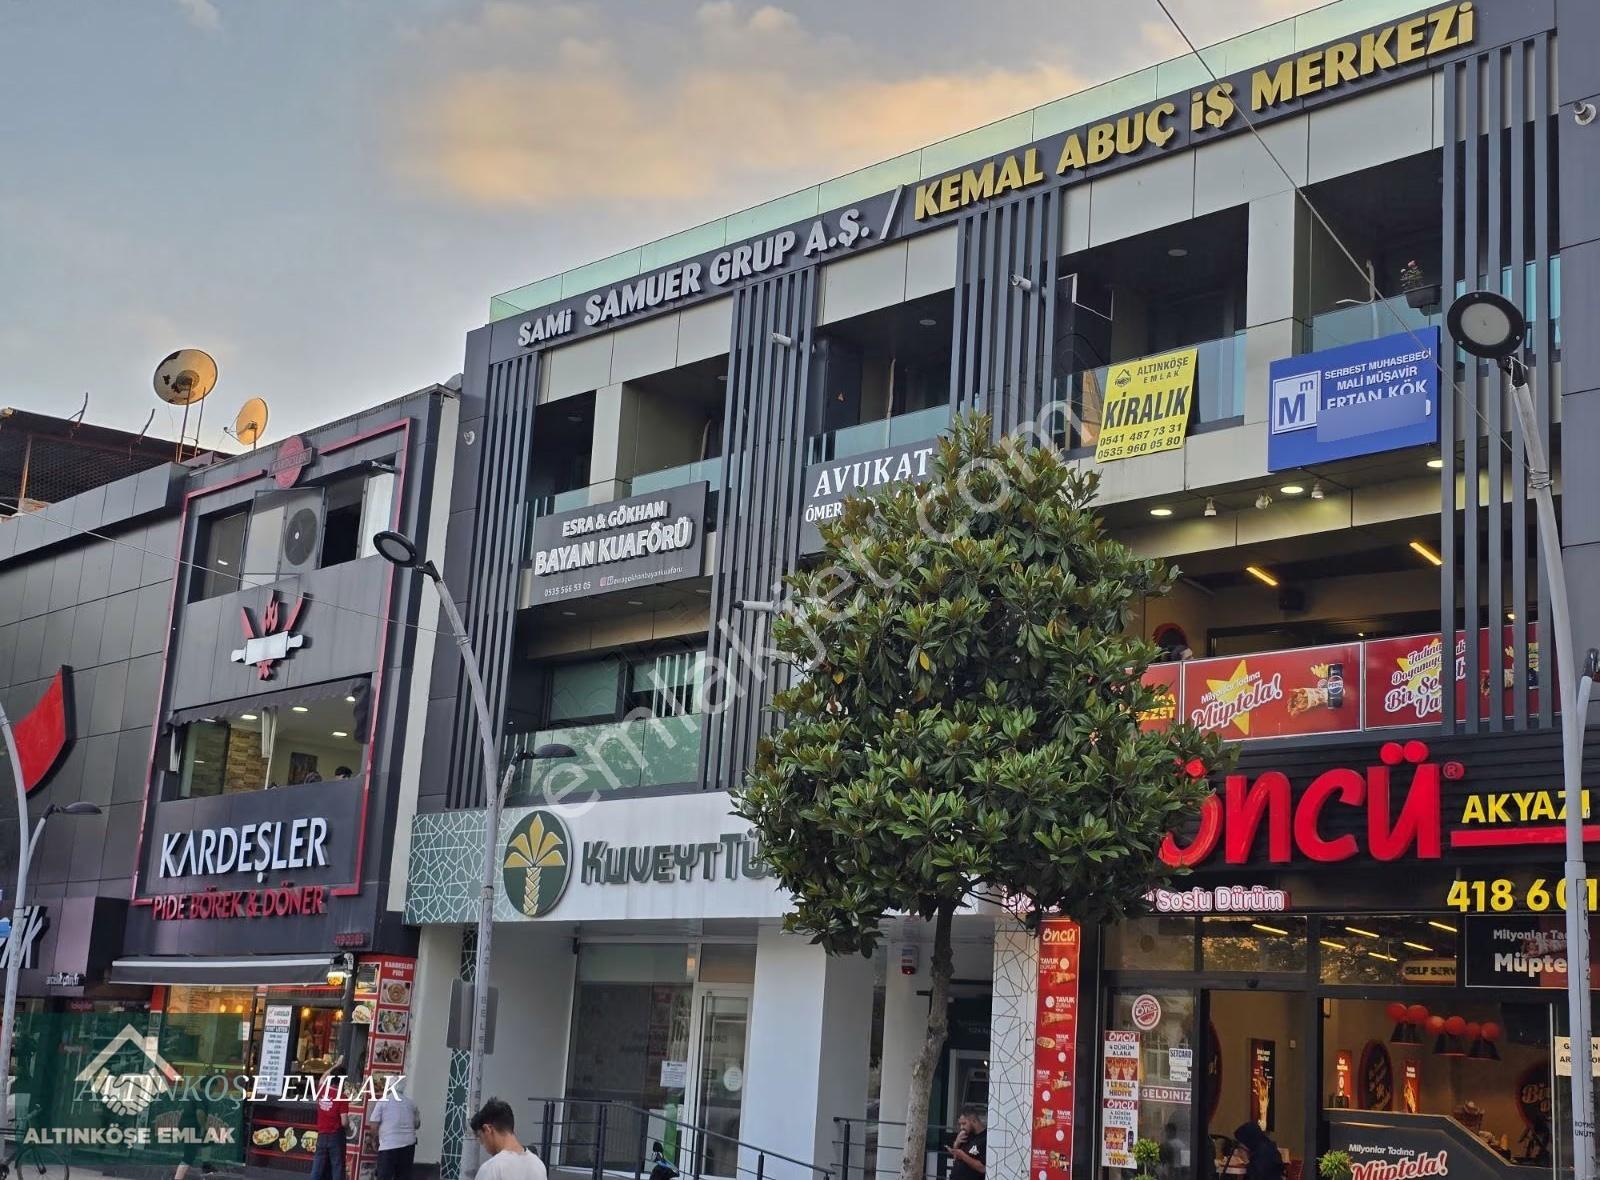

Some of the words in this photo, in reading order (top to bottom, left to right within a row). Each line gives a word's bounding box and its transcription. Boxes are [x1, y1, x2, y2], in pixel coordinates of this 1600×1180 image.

[584, 262, 702, 326] SAMUER
[709, 230, 796, 287] GRUP
[803, 208, 871, 258] A.Ş.
[914, 148, 1044, 221] KEMAL
[1056, 102, 1175, 176] ABUÇ
[1137, 356, 1189, 376] ALTINKÖŞE
[1143, 369, 1180, 384] EMLAK
[1324, 363, 1367, 380] SERBEST
[1337, 374, 1364, 391] MALİ
[1366, 365, 1418, 385] MÜŞAVİR
[1388, 379, 1428, 398] KÖK
[1103, 386, 1190, 430] KİRALIK
[1100, 434, 1125, 447] 0541
[1129, 430, 1150, 442] 487
[1153, 424, 1165, 437] 73
[1168, 422, 1182, 433] 31
[1150, 439, 1163, 450] 05
[1167, 435, 1180, 447] 80
[813, 447, 933, 498] AVUKAT
[562, 515, 594, 538] ESRA
[595, 513, 606, 530] &
[607, 500, 668, 528] GÖKHAN
[805, 502, 843, 522] ÖMER
[534, 540, 598, 576] BAYAN
[598, 516, 693, 563] KUAFÖRÜ
[159, 816, 329, 883] KARDEŞLER
[189, 884, 244, 920] BÖREK
[246, 890, 258, 918] &
[263, 880, 324, 917] DÖNER
[1156, 886, 1213, 913] Soslu
[1214, 885, 1285, 912] Dürüm
[1446, 879, 1514, 912] 418
[1493, 929, 1548, 942] Milyonlar
[1348, 1143, 1387, 1155] Milyonlar
